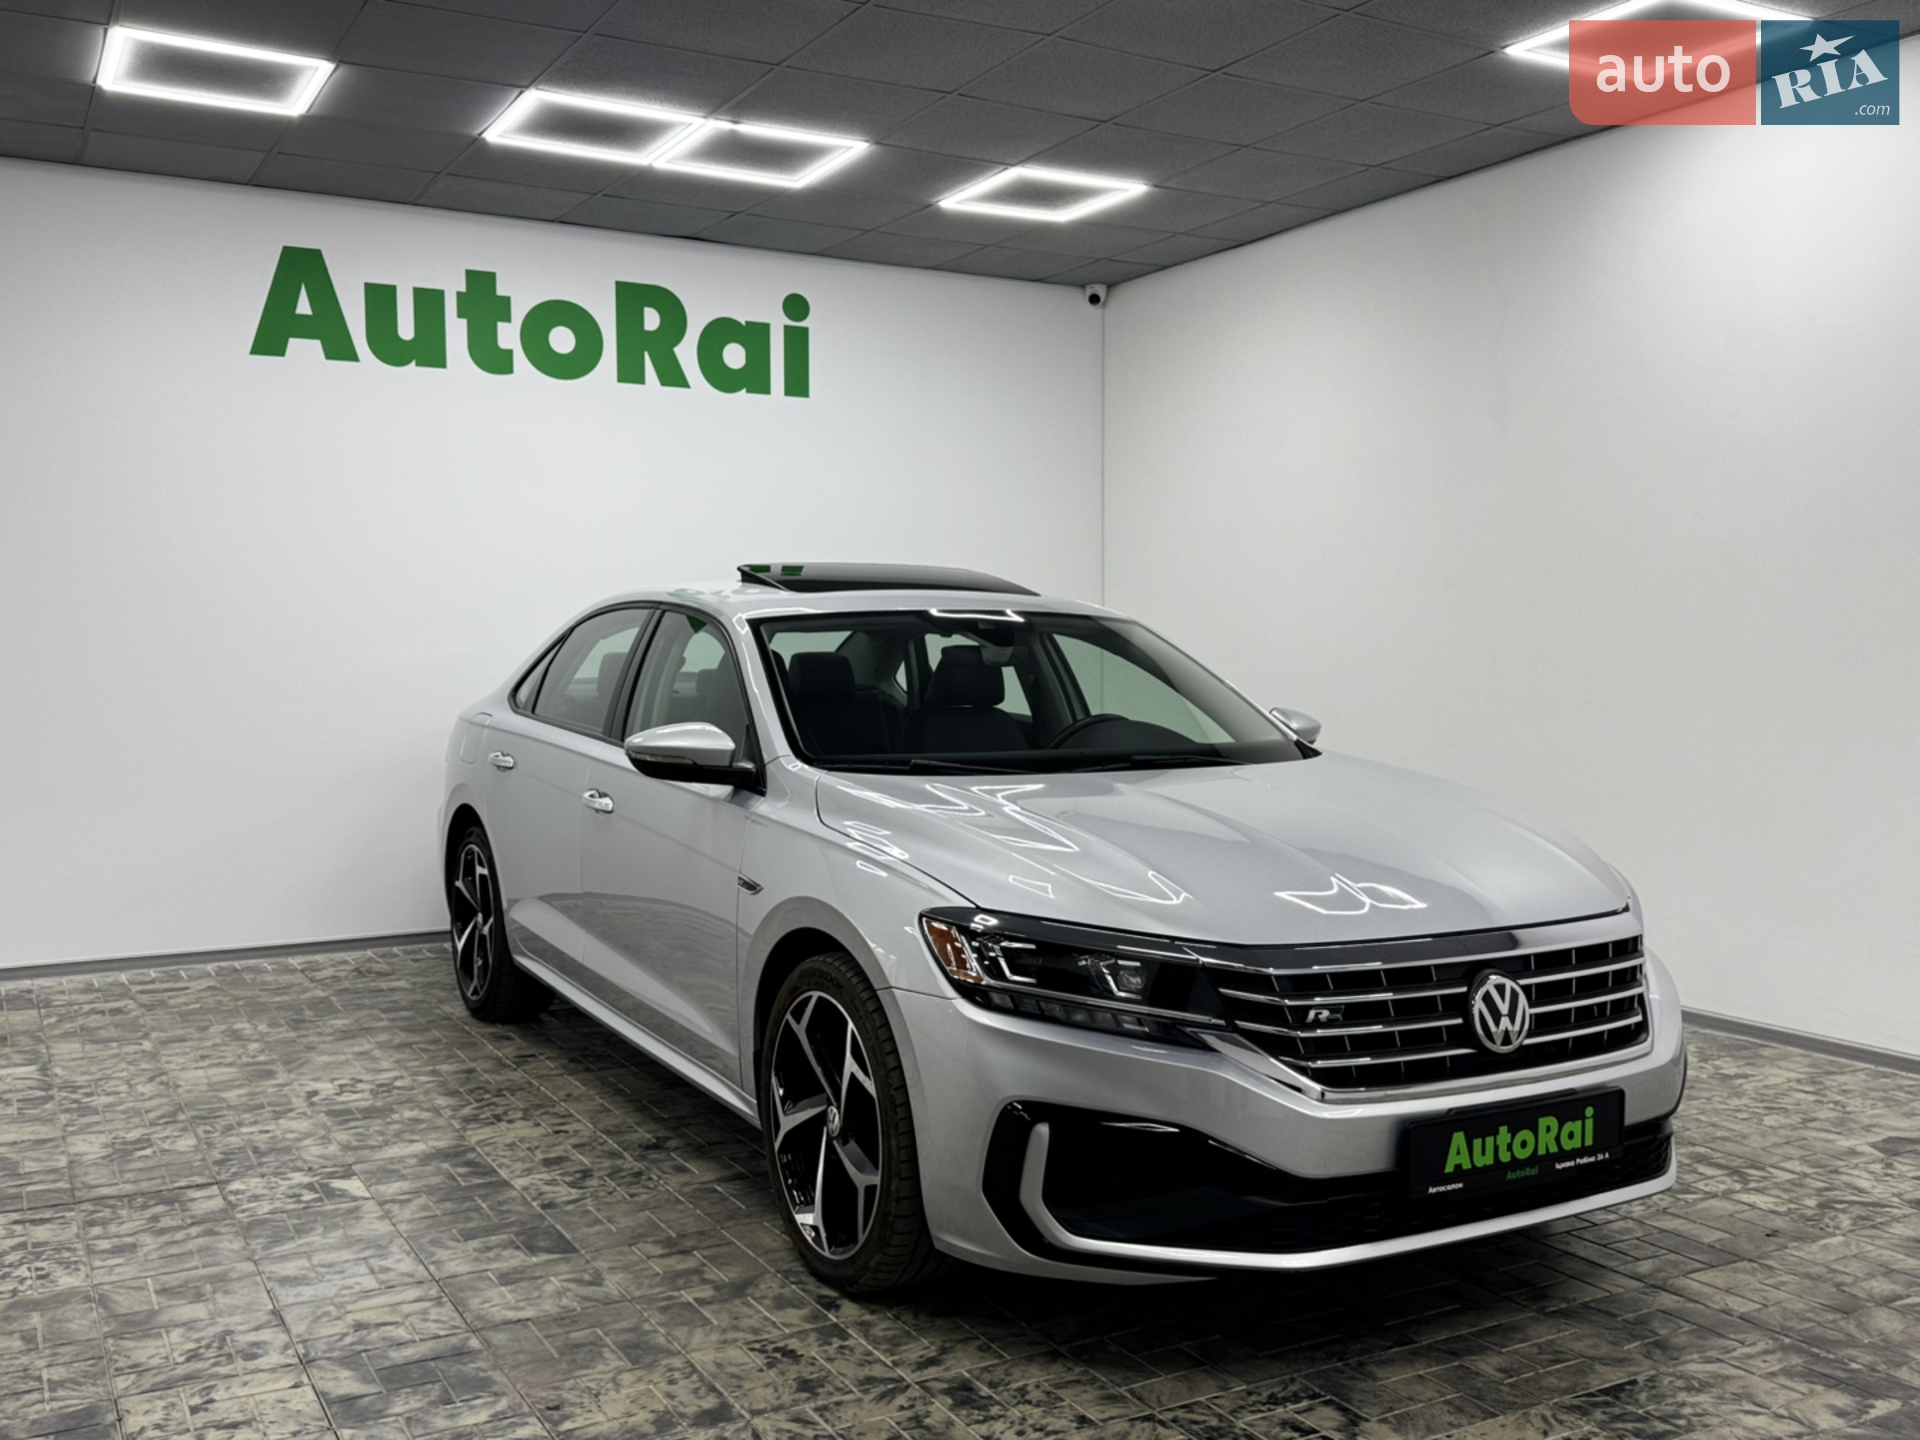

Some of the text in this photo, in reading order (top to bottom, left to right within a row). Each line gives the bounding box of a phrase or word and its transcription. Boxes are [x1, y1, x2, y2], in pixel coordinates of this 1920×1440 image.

[249, 245, 811, 399] AutoRai
[1444, 1106, 1594, 1174] AutoRai
[1506, 1165, 1538, 1181] AutoRai
